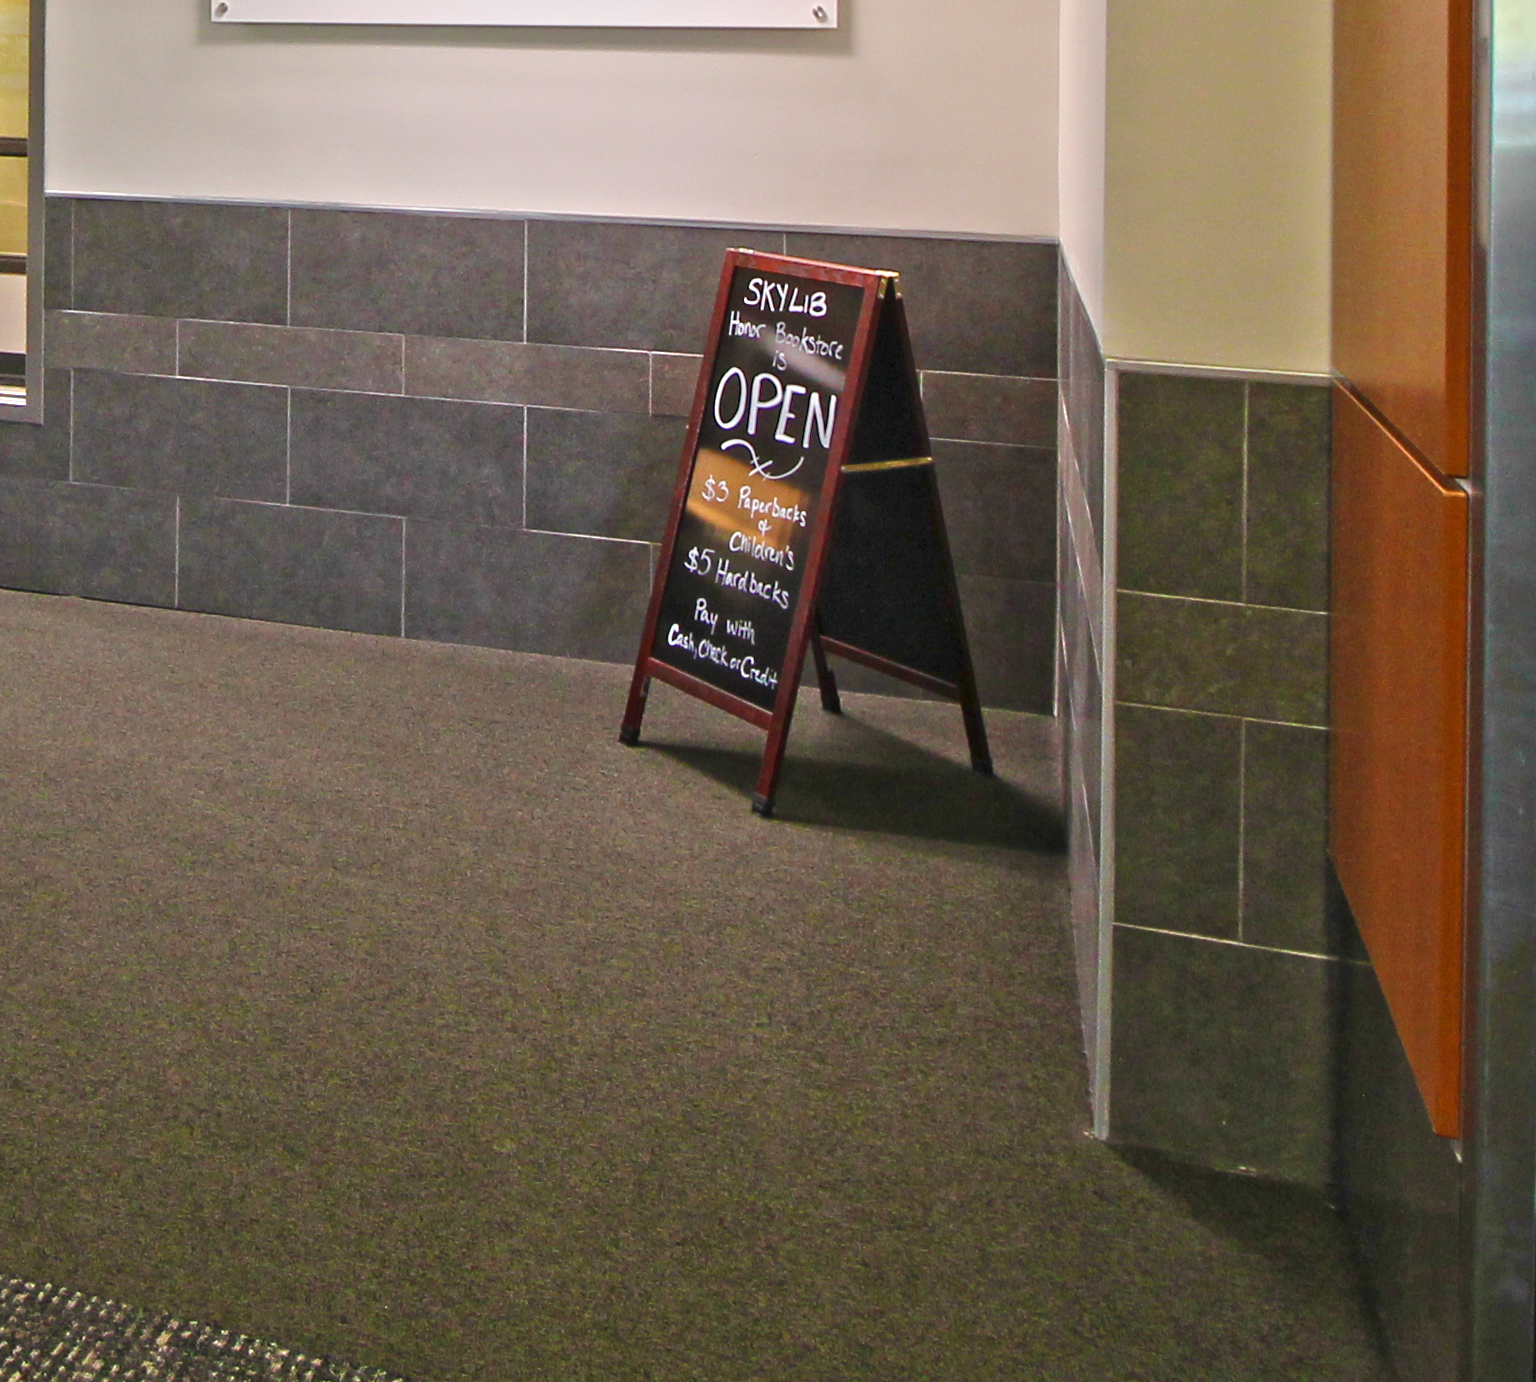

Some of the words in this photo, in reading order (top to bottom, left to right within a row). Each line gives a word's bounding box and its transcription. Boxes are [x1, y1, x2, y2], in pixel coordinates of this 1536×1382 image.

[743, 277, 828, 317] SKYLIB
[728, 310, 767, 339] Honor
[774, 321, 844, 360] Bookstore
[772, 349, 788, 372] is
[714, 366, 837, 449] OPEN
[701, 474, 730, 502] $3
[737, 485, 807, 528] Paperbacks
[728, 531, 795, 572] Children's
[683, 546, 716, 576] $5
[715, 557, 790, 610] Hardbacks
[693, 597, 719, 635] Pay
[726, 619, 756, 645] with
[729, 656, 742, 671] or
[739, 655, 779, 691] Credit
